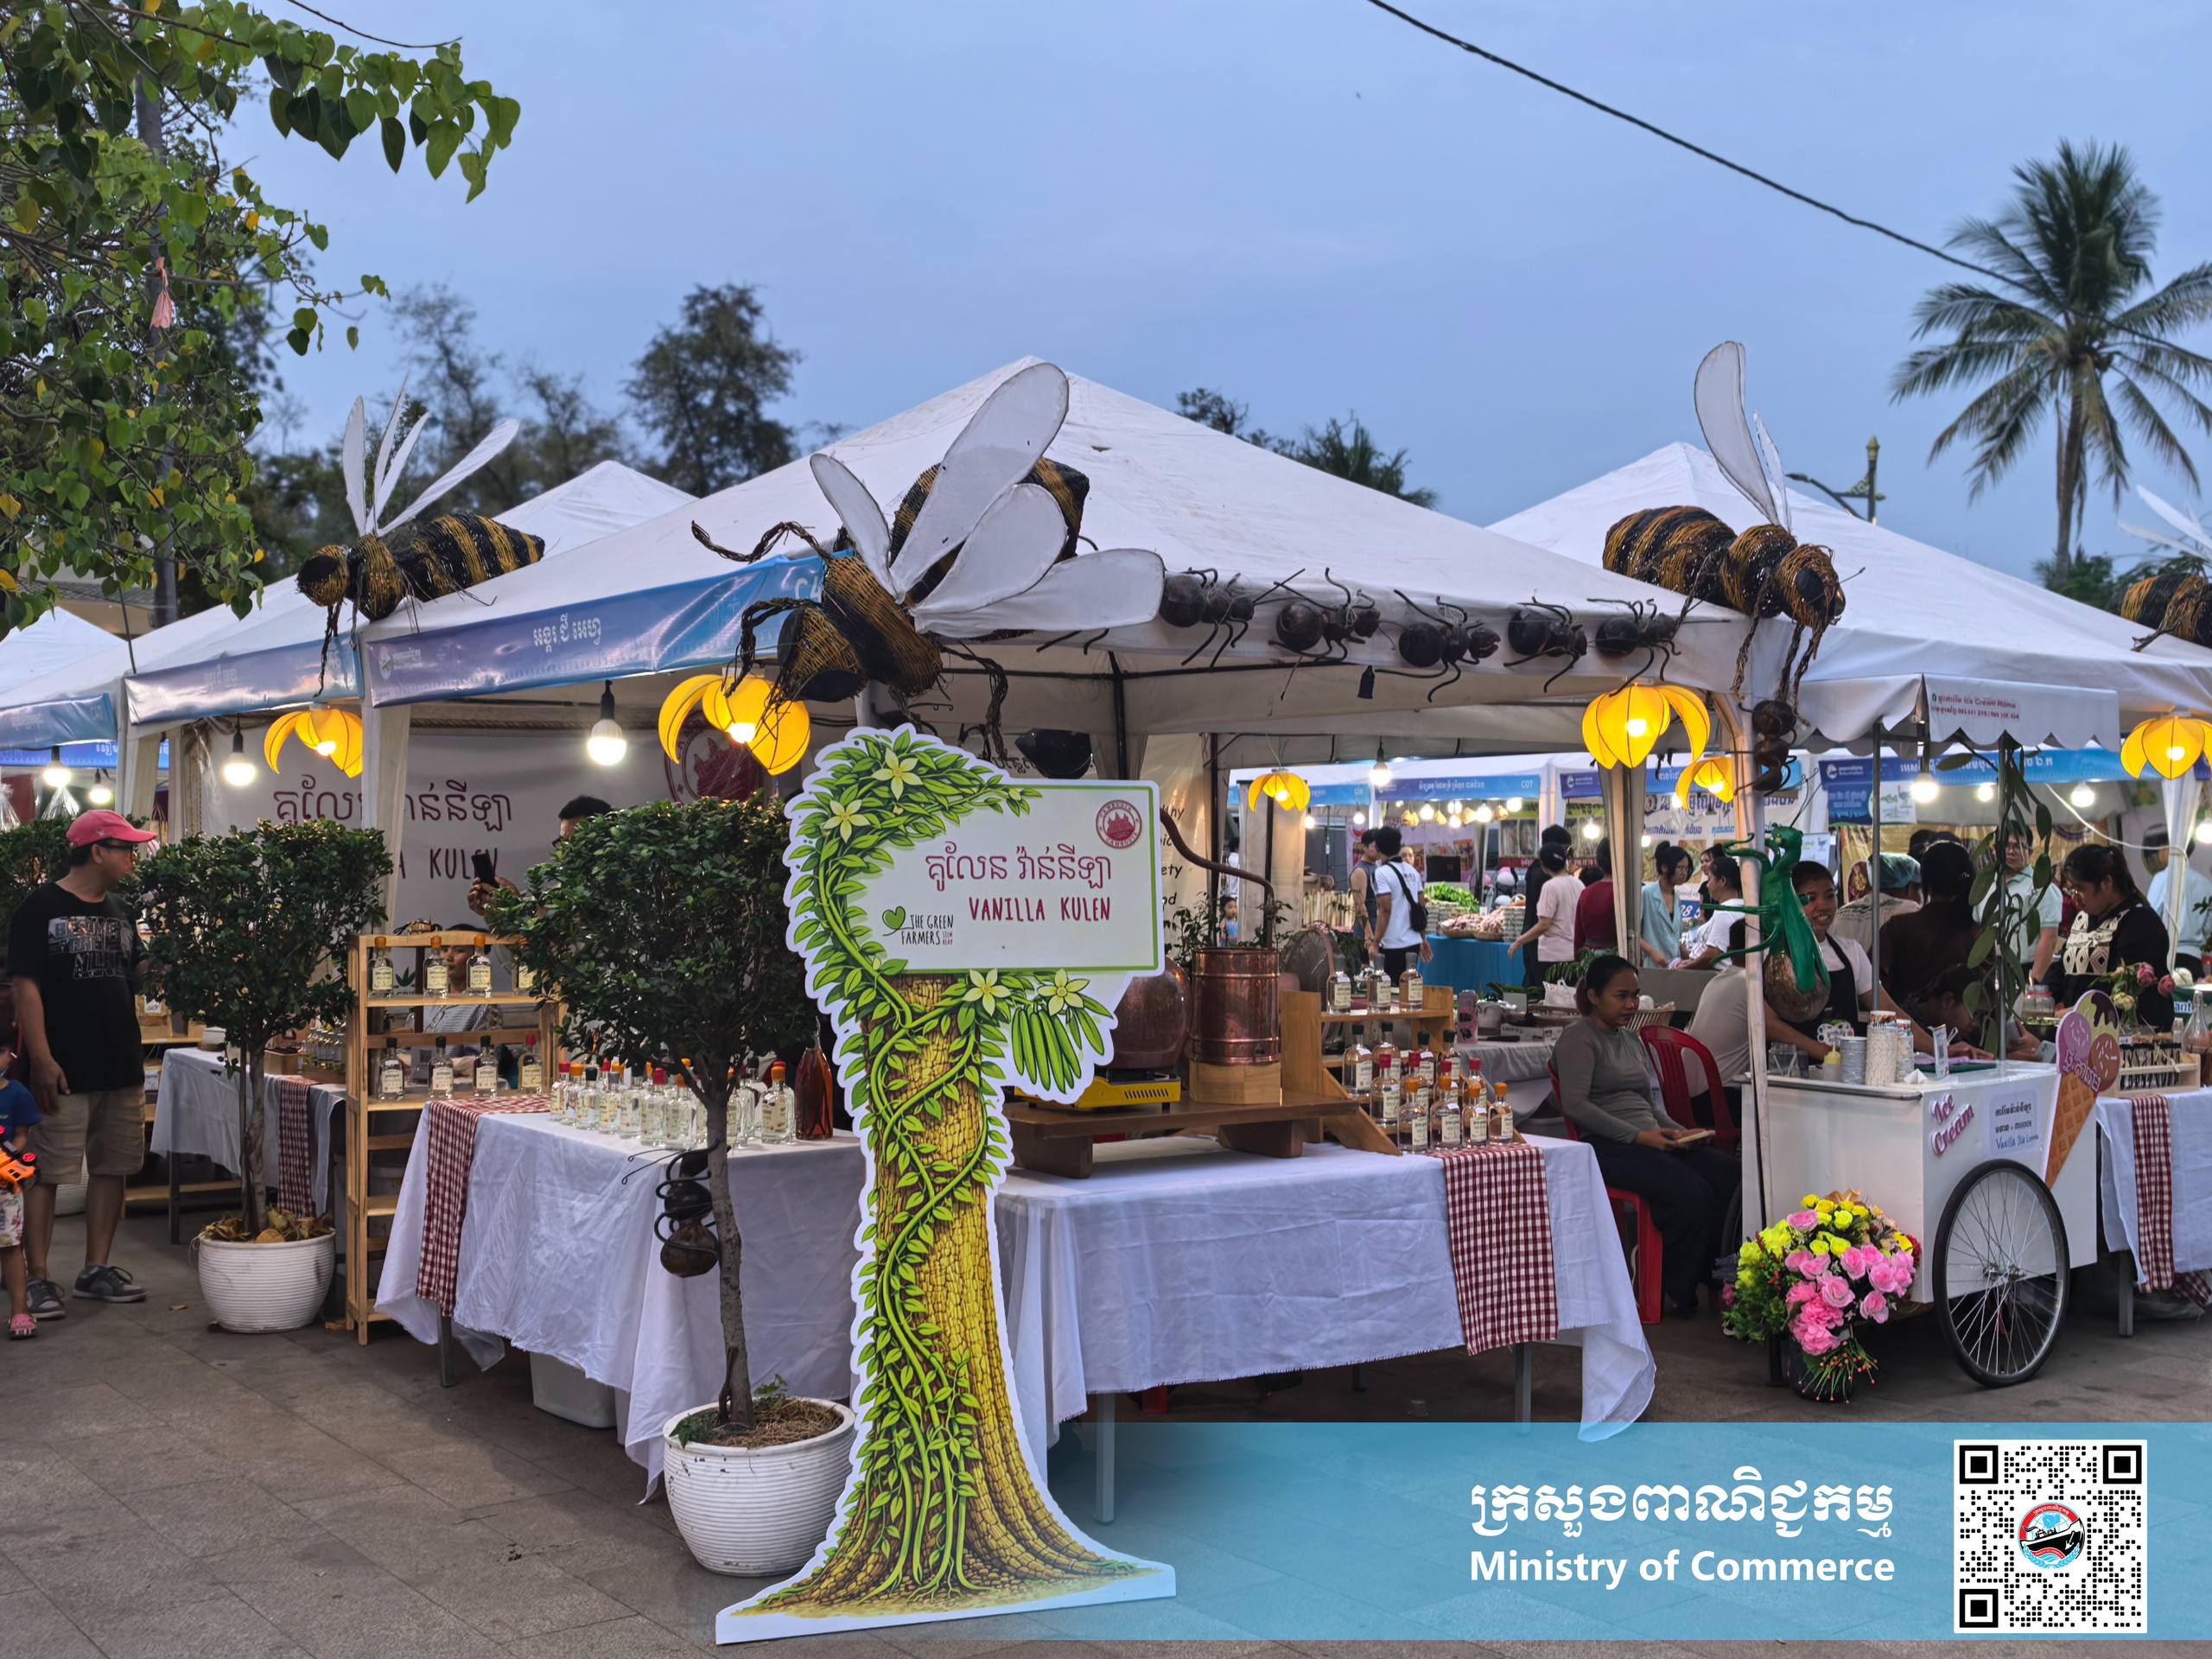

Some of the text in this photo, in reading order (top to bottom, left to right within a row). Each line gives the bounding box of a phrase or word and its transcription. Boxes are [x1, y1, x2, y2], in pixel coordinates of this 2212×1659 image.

[1521, 780, 1534, 789] C07
[273, 774, 512, 832] គូលែ ាន់នីឡា
[429, 848, 498, 880] KULN
[925, 841, 1007, 892] គូលែន
[910, 914, 954, 930] THE GREEN
[969, 896, 1110, 922] VANILLA KULEN
[901, 931, 940, 945] FARMERS
[1931, 1093, 1955, 1124] Ice
[1931, 1103, 1974, 1157] Cream
